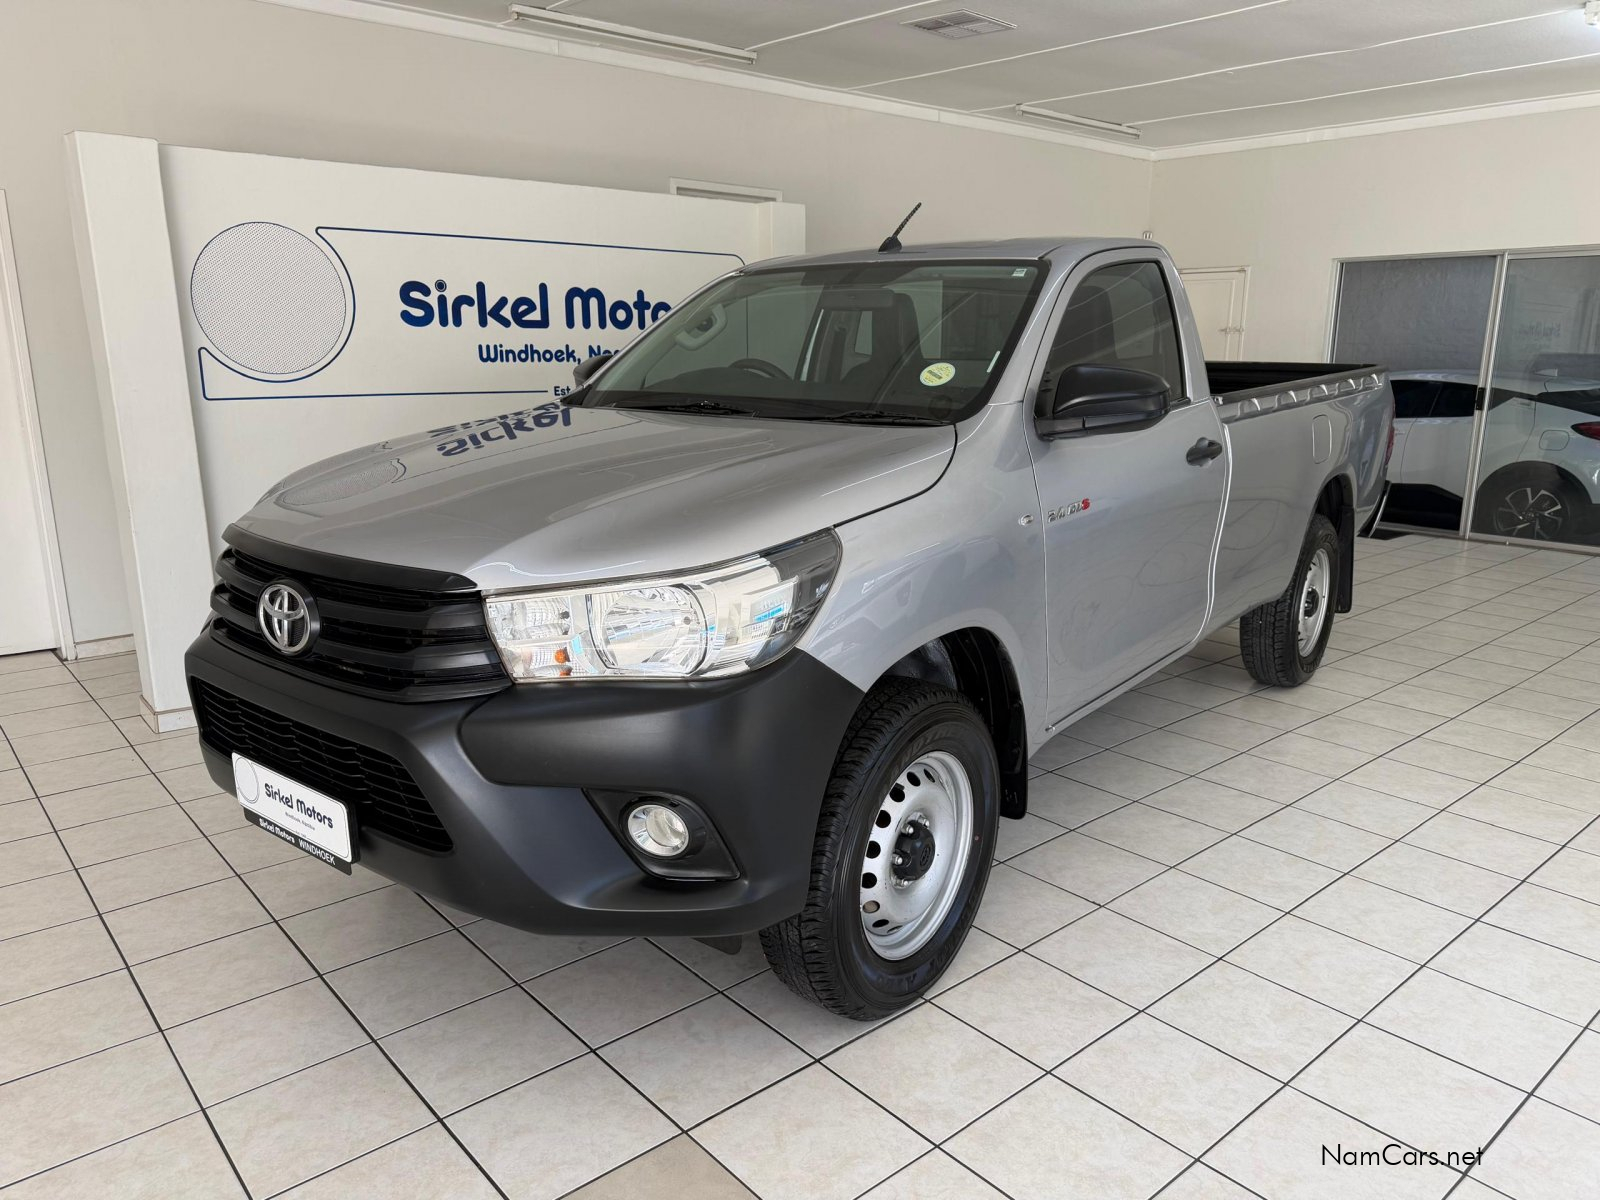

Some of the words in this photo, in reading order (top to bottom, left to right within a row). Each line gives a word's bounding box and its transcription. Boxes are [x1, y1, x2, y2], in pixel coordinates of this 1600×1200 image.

[399, 279, 550, 329] Sirkel
[478, 344, 582, 365] Windhoek,
[264, 783, 294, 809] Sirkel
[296, 798, 334, 829] Motors
[274, 826, 295, 844] Motors
[299, 839, 336, 866] WINDHOEK
